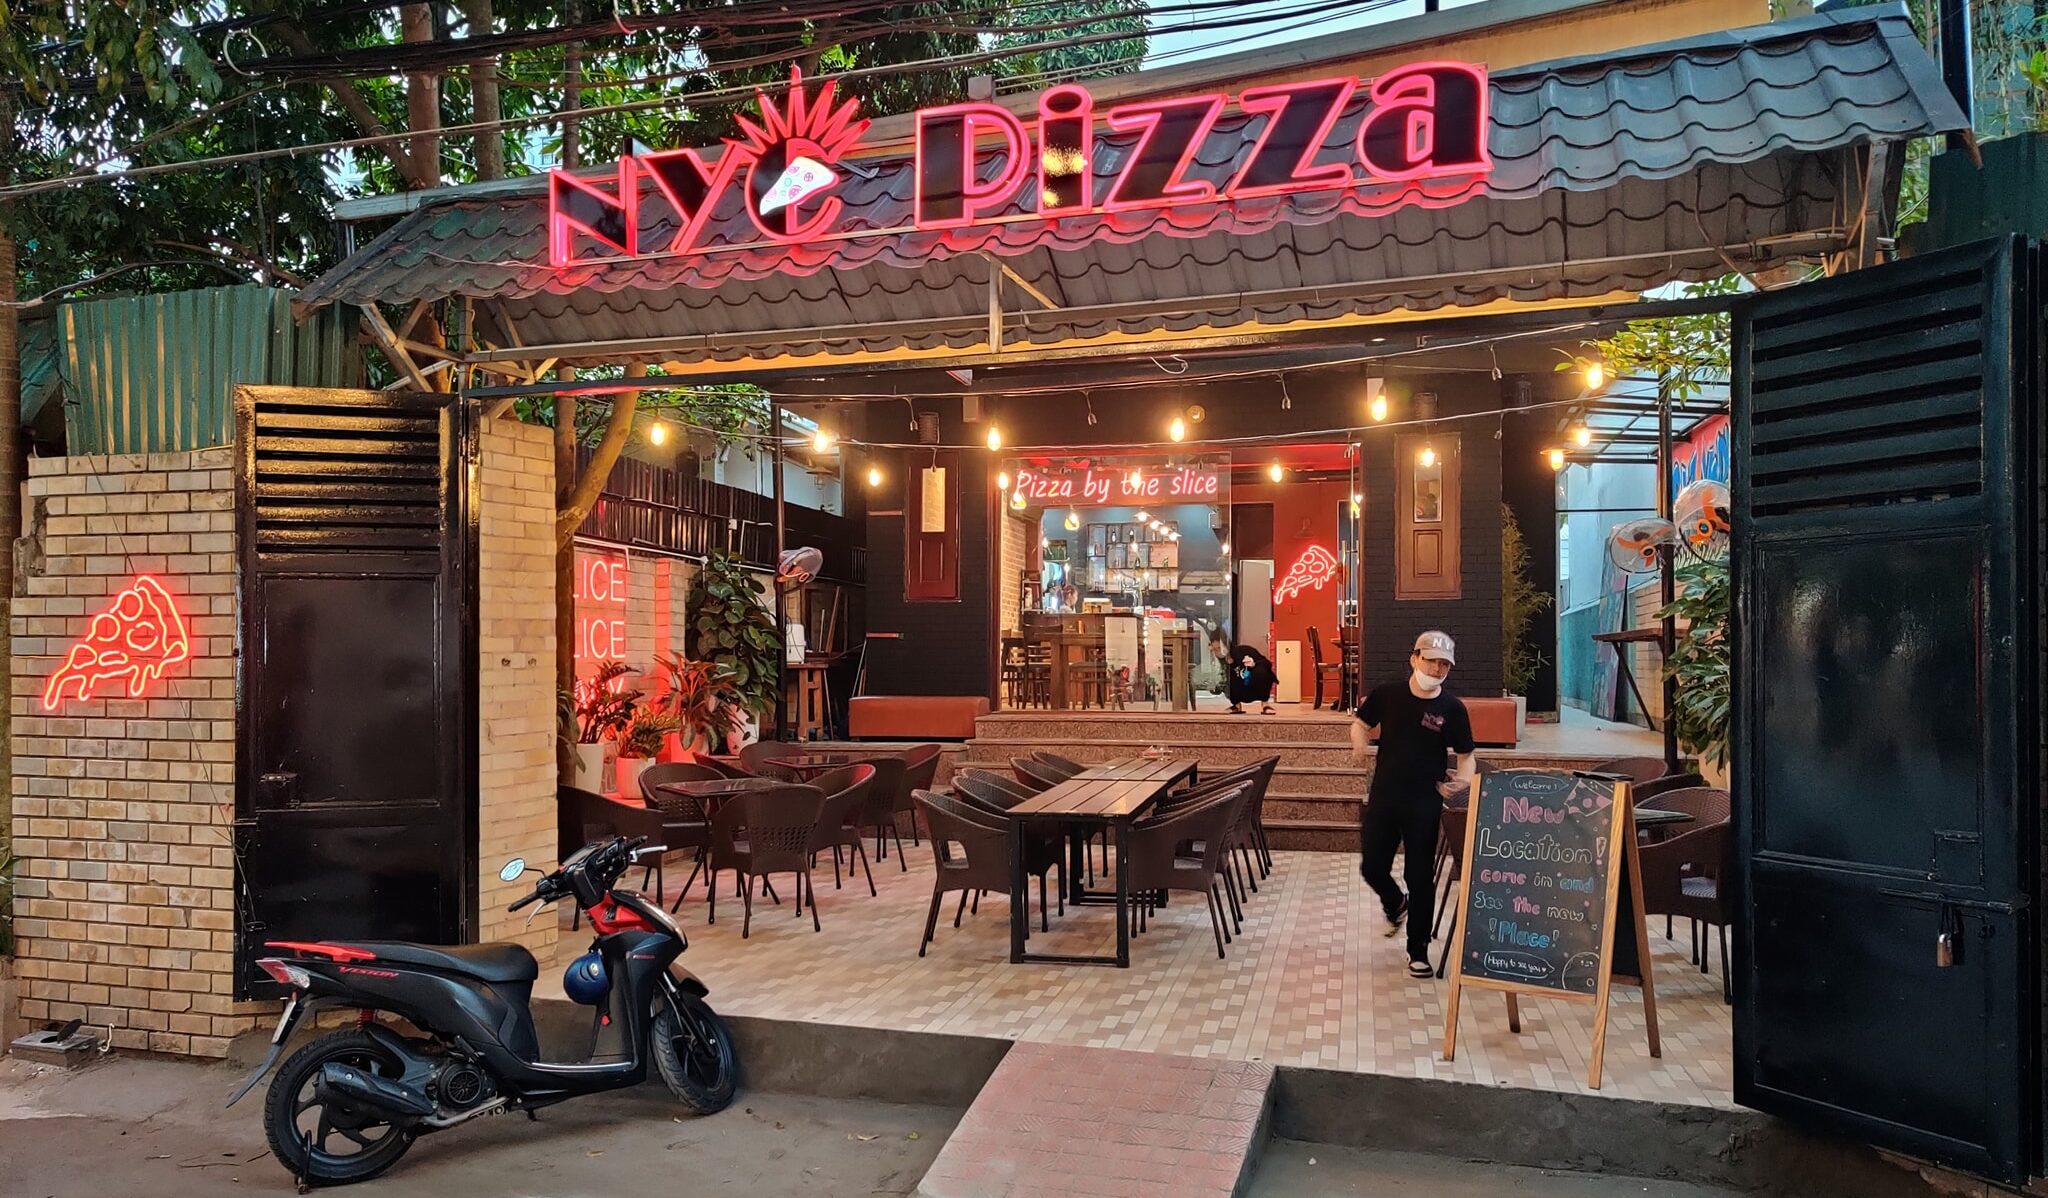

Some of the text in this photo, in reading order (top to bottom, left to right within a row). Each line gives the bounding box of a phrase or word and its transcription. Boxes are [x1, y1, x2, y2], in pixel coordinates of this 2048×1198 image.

[549, 130, 842, 267] NYC
[1016, 468, 1217, 503] Pizza by the slice
[1502, 796, 1566, 824] New
[1480, 869, 1595, 894] come in and
[1512, 896, 1541, 916] the
[1546, 906, 1585, 923] new
[1487, 955, 1508, 969] Happy
[1509, 958, 1517, 968] to
[1527, 964, 1541, 973] you
